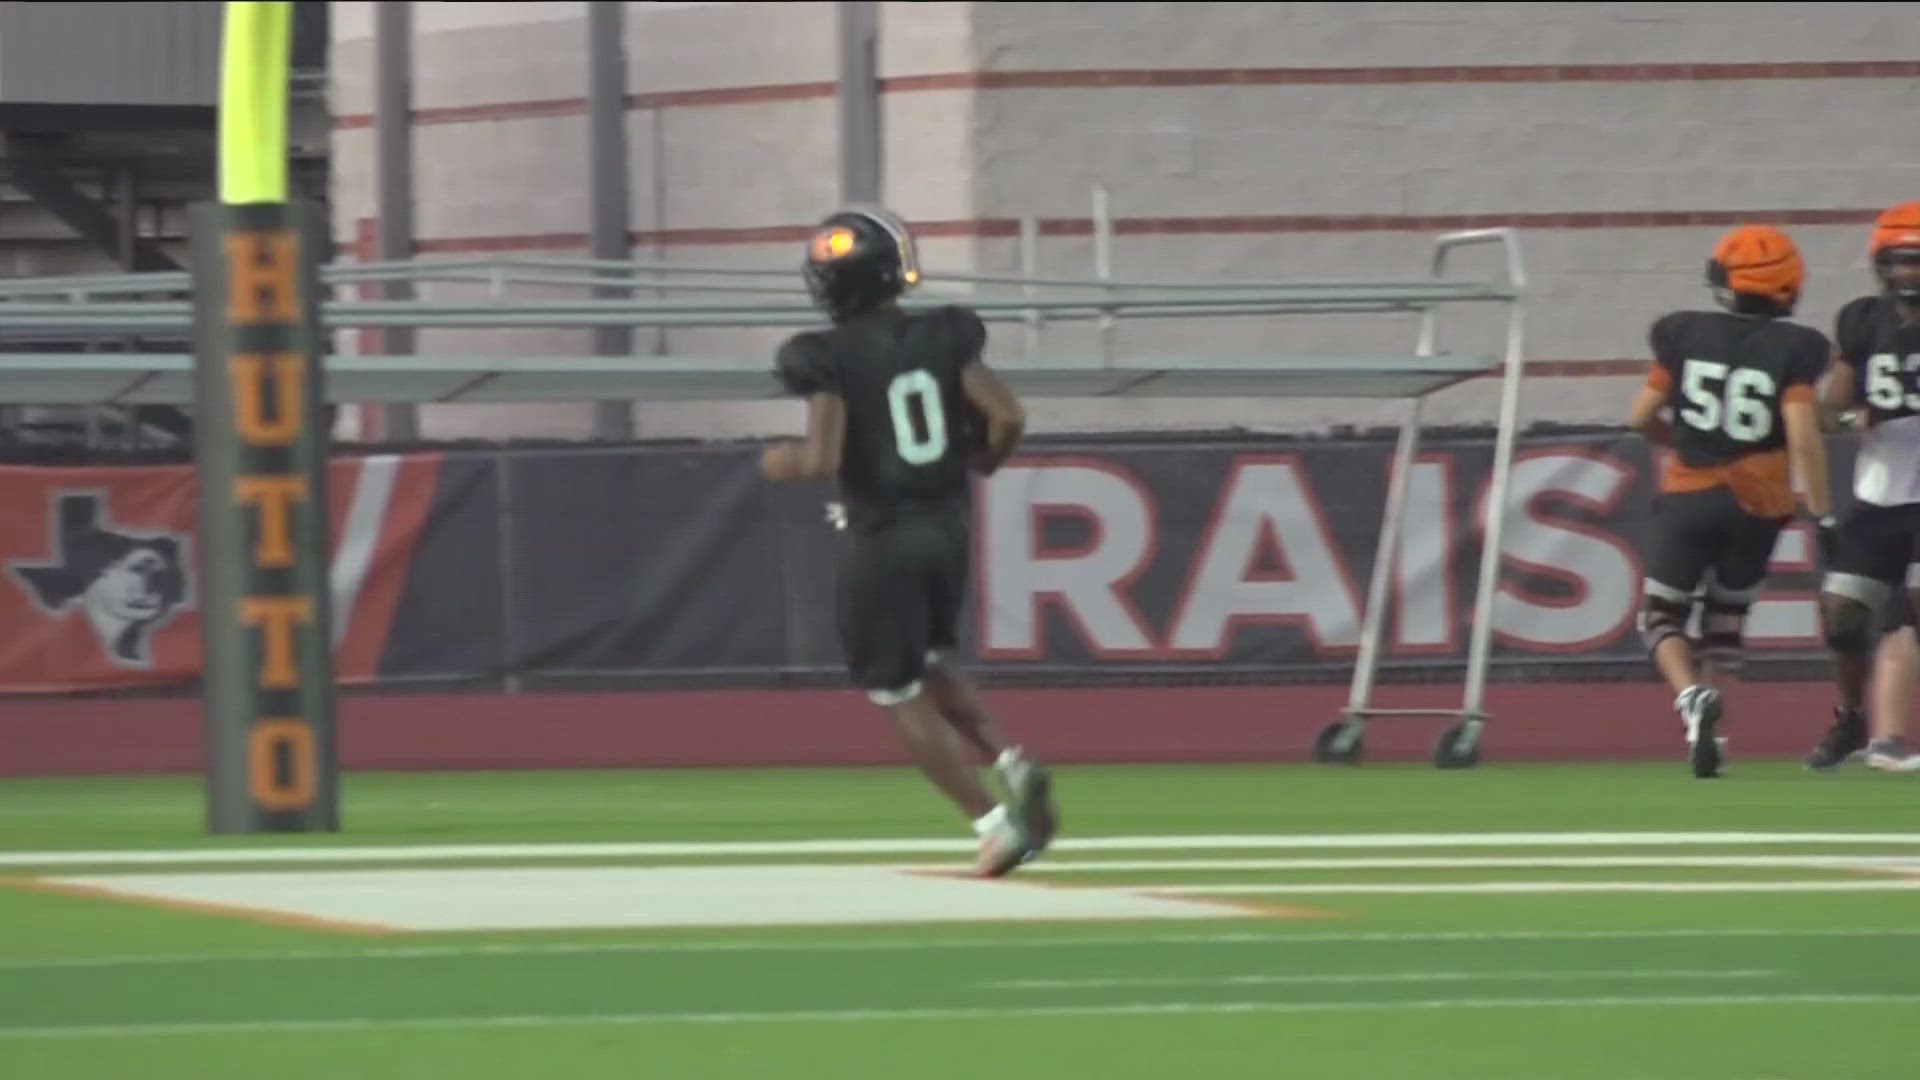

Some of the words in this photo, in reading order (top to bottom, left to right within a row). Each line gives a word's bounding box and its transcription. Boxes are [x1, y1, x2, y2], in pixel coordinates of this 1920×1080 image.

[888, 369, 947, 466] 0
[1681, 359, 1775, 442] 56
[225, 233, 318, 810] HUTTO
